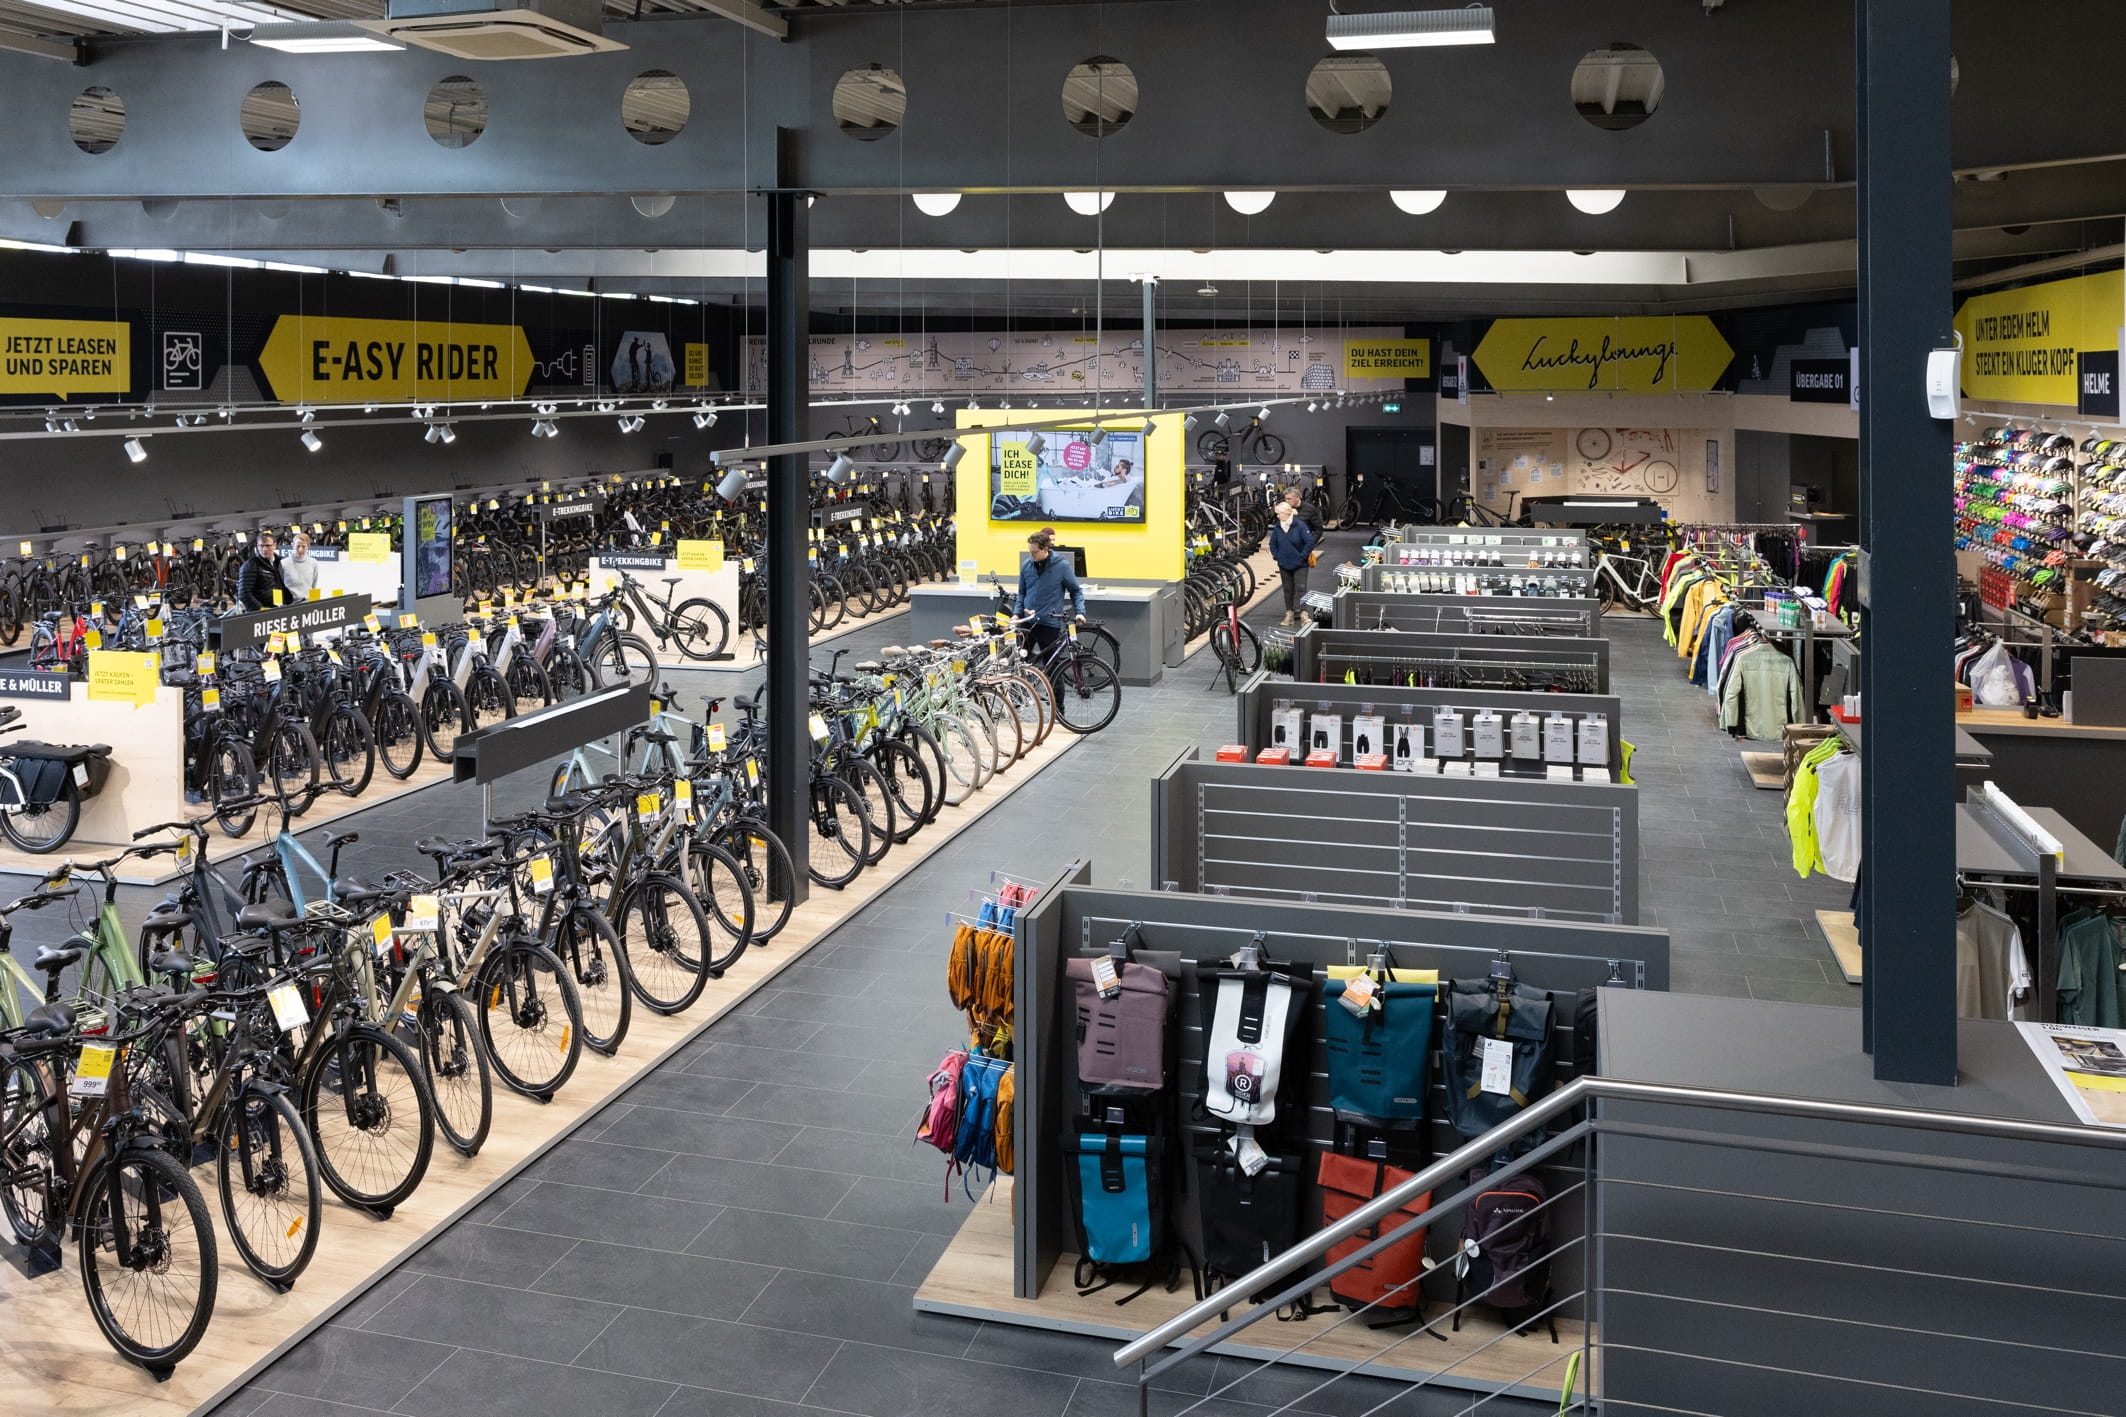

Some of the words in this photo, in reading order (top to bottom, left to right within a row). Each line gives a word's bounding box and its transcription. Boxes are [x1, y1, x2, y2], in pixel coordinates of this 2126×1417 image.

[1976, 317, 1998, 342] UNTER
[1999, 314, 2024, 340] JEDEM
[2026, 311, 2050, 338] HELM
[6, 336, 53, 355] JETZT
[58, 338, 117, 355] LEASEN
[1351, 348, 1363, 358] DU
[1367, 348, 1389, 358] HAST
[1396, 348, 1418, 358] DEIN
[6, 359, 44, 376] UND
[48, 359, 112, 376] SPAREN
[313, 341, 405, 381] E-ASY
[417, 343, 498, 380] RIDER
[1351, 359, 1372, 368] ZIEL
[1374, 358, 1424, 368] ERREICHT!
[1521, 335, 1678, 389] Luckylounge
[1976, 352, 2000, 377] STECKT
[2002, 351, 2014, 376] EIN
[2016, 349, 2048, 376] KLUGER
[2050, 348, 2074, 376] KOPF
[1796, 370, 1833, 388] ÜBERGABE
[1835, 371, 1843, 388] 01
[2084, 372, 2110, 395] HELME
[1004, 450, 1019, 459] ICH
[1004, 460, 1032, 469] LEASE
[1004, 470, 1029, 479] DICH!
[553, 503, 593, 516] E-TREKKINGBIKE
[254, 618, 287, 637] RIESE
[291, 617, 298, 630] &
[302, 606, 346, 626] MÜLLER
[0, 679, 7, 690] E
[9, 679, 17, 690] &
[20, 678, 62, 693] MÜLLER
